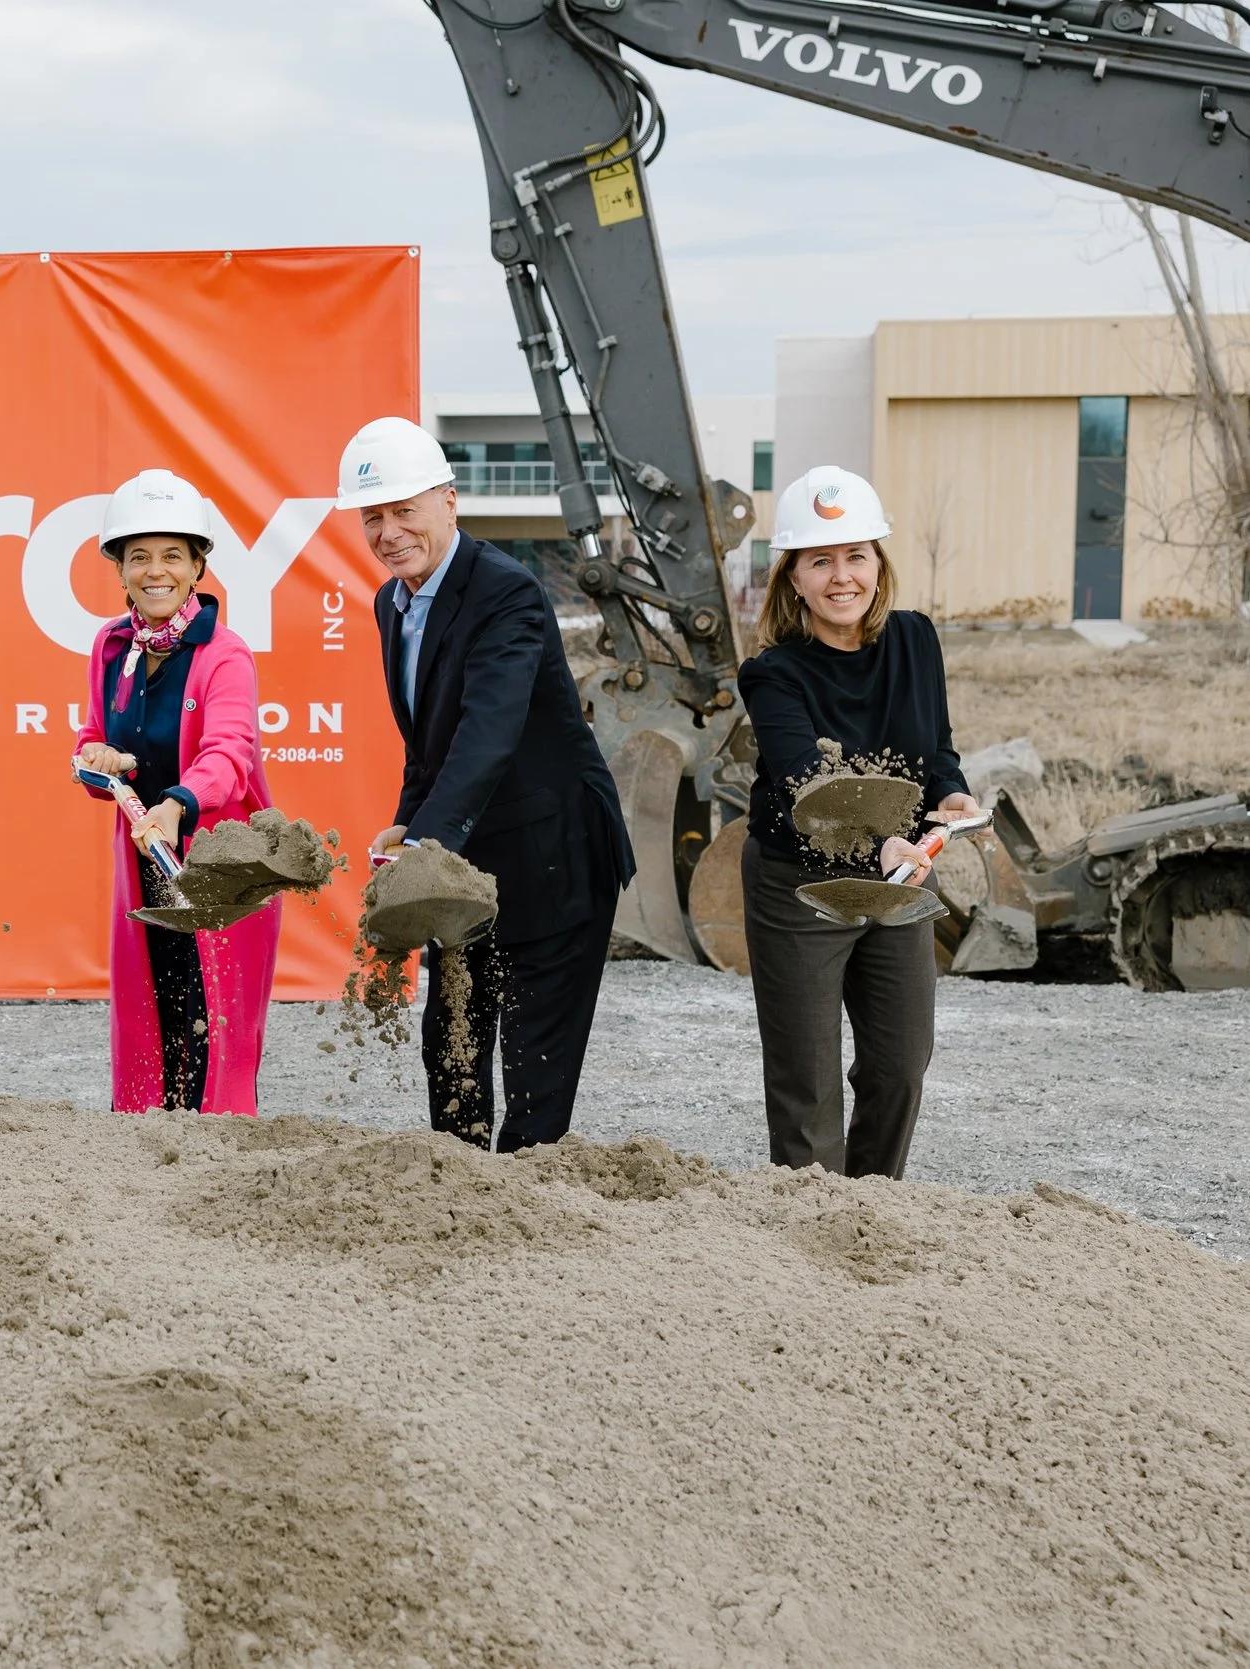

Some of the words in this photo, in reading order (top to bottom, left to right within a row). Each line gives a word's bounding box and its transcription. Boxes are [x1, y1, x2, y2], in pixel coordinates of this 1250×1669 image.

[728, 18, 983, 105] VOLVO
[323, 582, 344, 651] INC.
[260, 747, 344, 762] 7-3084-05
